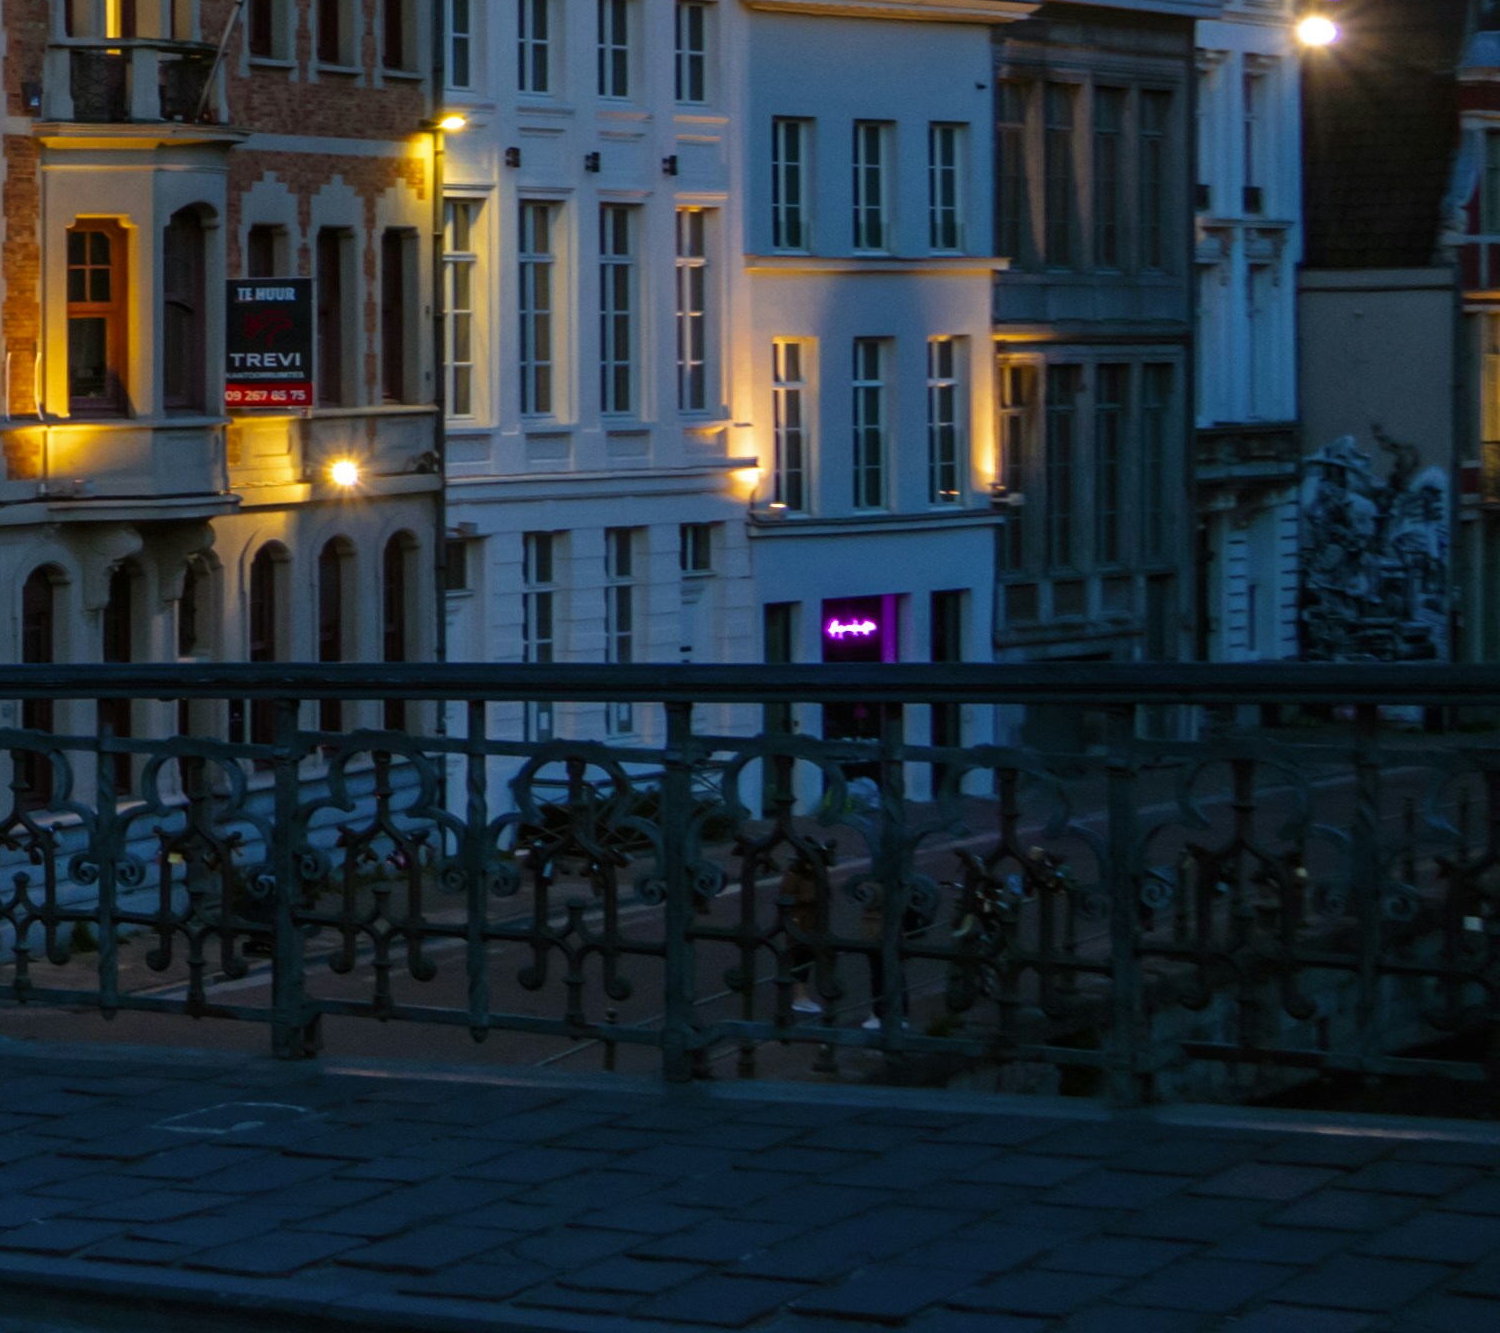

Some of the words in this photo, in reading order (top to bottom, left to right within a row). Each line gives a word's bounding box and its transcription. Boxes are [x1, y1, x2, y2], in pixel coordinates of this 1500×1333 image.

[236, 287, 253, 301] TE
[255, 287, 297, 301] HUUR
[229, 353, 301, 367] TREVI
[224, 390, 242, 401] 09
[244, 390, 268, 401] 267
[289, 389, 307, 401] 75
